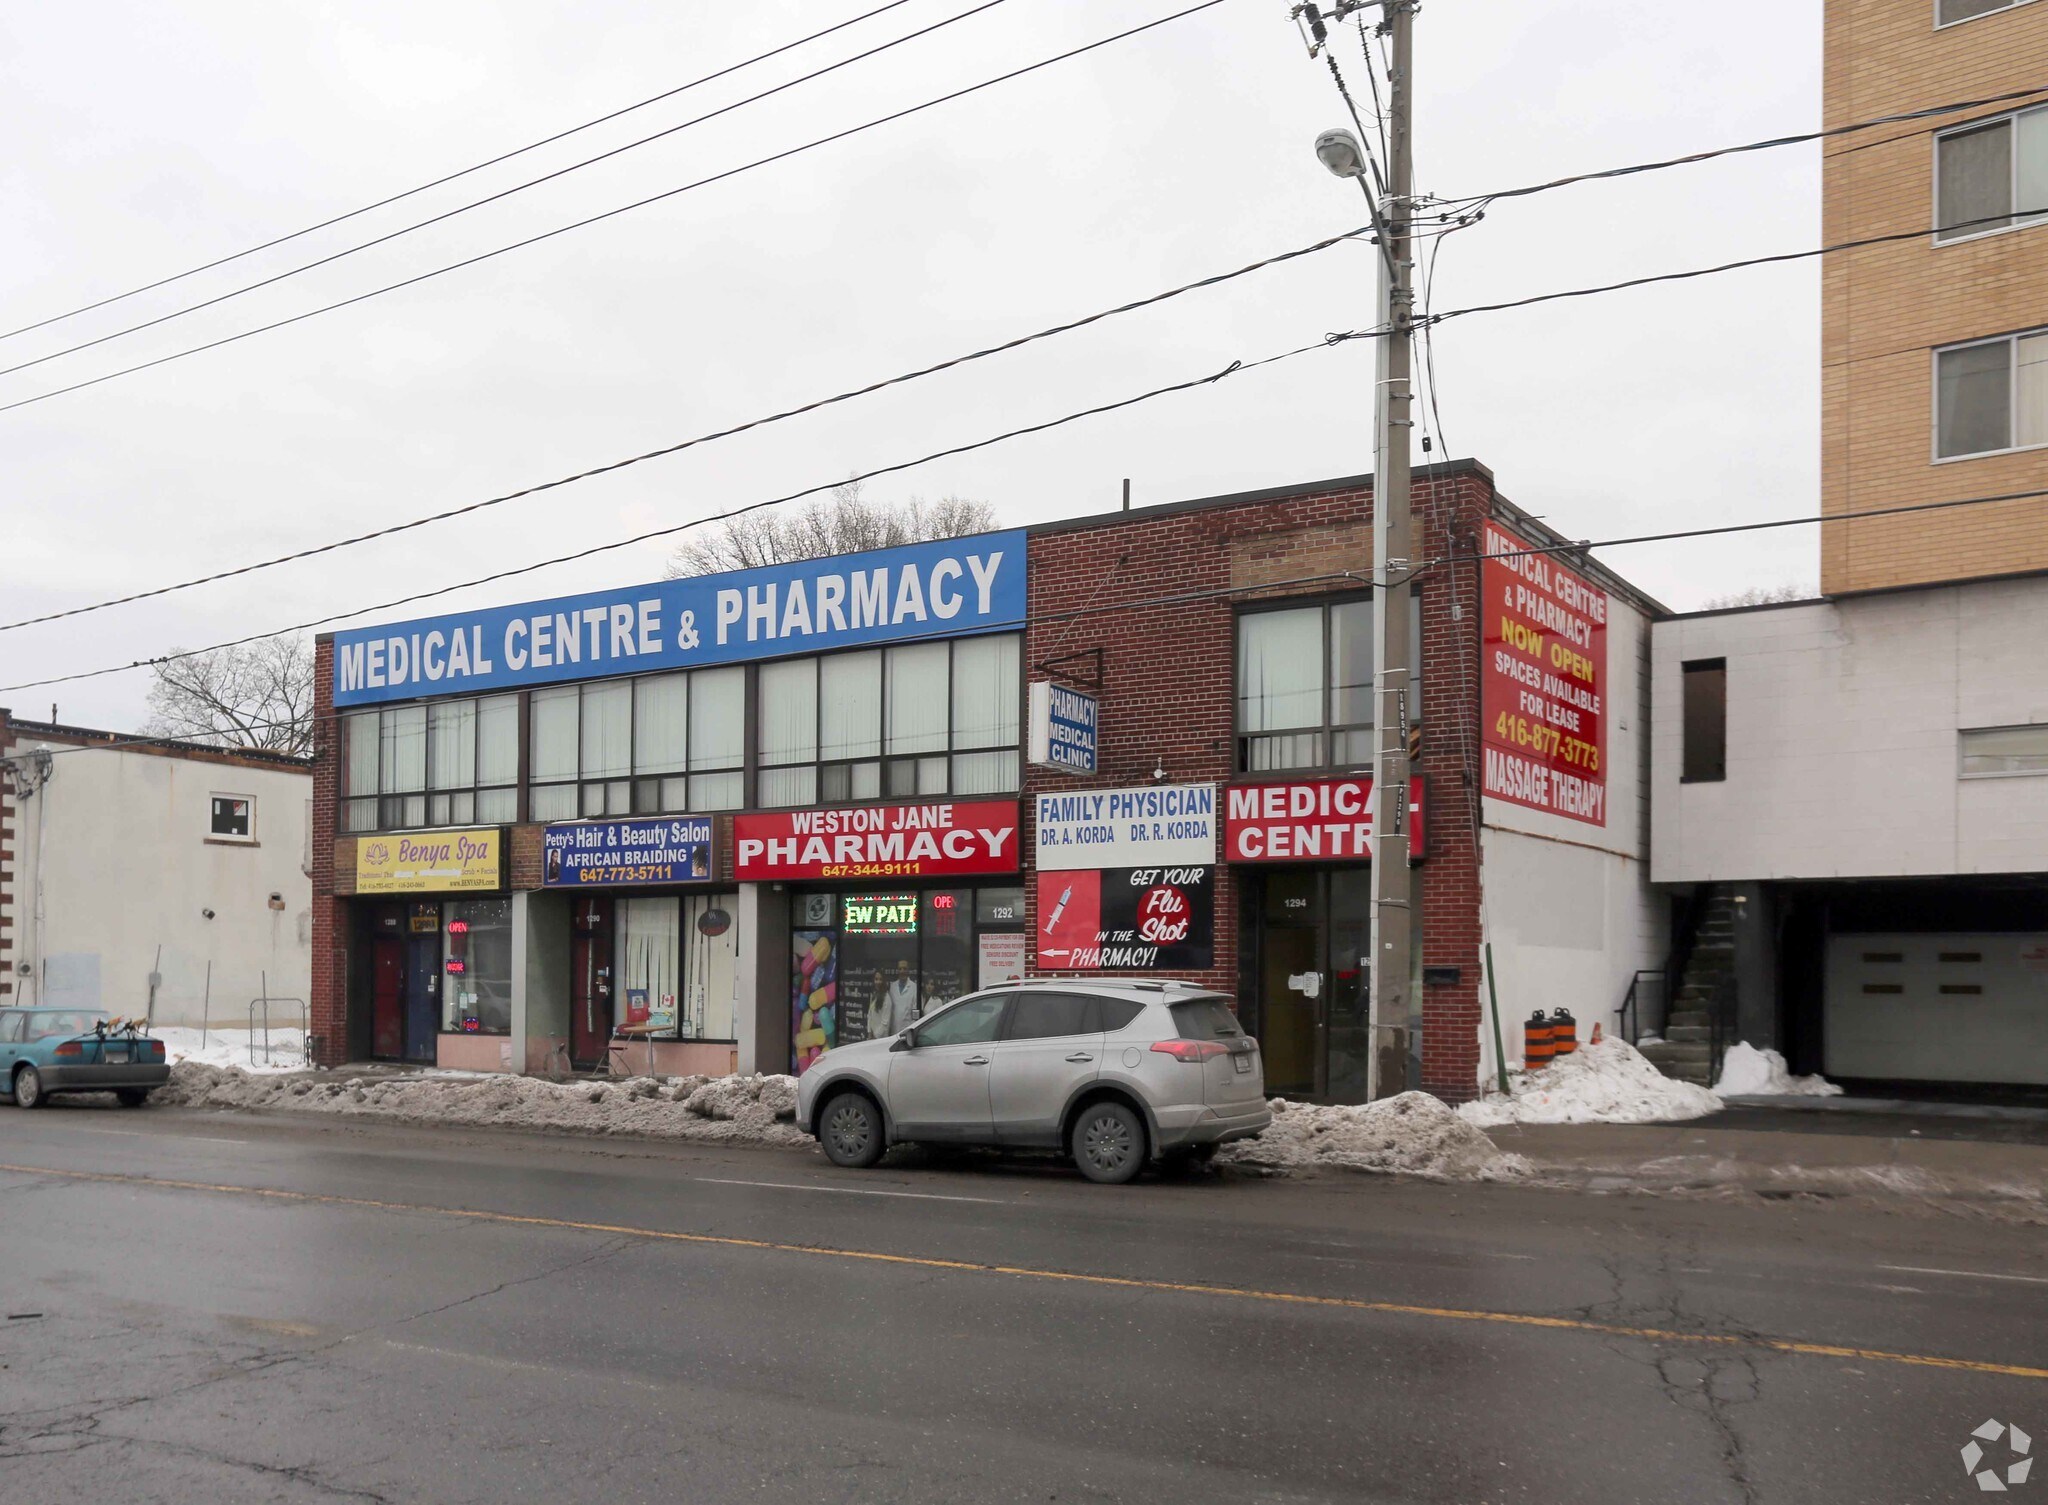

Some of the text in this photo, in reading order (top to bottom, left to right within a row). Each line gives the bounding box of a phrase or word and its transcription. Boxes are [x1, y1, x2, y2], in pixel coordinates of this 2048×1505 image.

[1486, 527, 1605, 624] MEDICAL CENTRE
[340, 551, 1004, 692] MEDICAL CENTRE & PHARMACY
[1504, 584, 1591, 649] & PHARMACY
[1501, 615, 1593, 683] NOW OPEN
[1495, 650, 1600, 716] SPACES AVAILABLE
[1049, 687, 1095, 727] PHARMACY
[1520, 690, 1580, 733] FOR LEASE
[1049, 722, 1094, 750] MEDICAL
[1495, 710, 1599, 771] 416-877-3773
[1052, 743, 1091, 769] CLINIC
[1485, 748, 1604, 820] MASSAGE THERAPY
[1040, 788, 1211, 823] FAMILY PHYSICIAN
[1229, 783, 1419, 820] MEDIC
[791, 804, 953, 835] WESTON JANE
[1041, 820, 1208, 846] DR. A. KORDA DR. R. KORDA
[545, 821, 709, 849] Petty's Hair & Beauty Salon
[738, 827, 1014, 866] PHARMACY
[1238, 823, 1373, 858] CENTR
[399, 836, 488, 869] Benya Spa
[565, 849, 687, 867] AFRICAN BRAIDING
[580, 865, 672, 882] 647-773-5711
[822, 863, 920, 877] 647-344-9111
[1130, 867, 1205, 886] GET YOUR
[992, 907, 1013, 919] 1292
[1146, 889, 1183, 914] Flu
[1284, 898, 1307, 908] 1294
[448, 921, 468, 933] OPEN
[586, 914, 600, 922] 1290
[1138, 916, 1188, 942] Shot
[1094, 930, 1134, 942] IN THE
[1068, 946, 1159, 968] PHARMACY!
